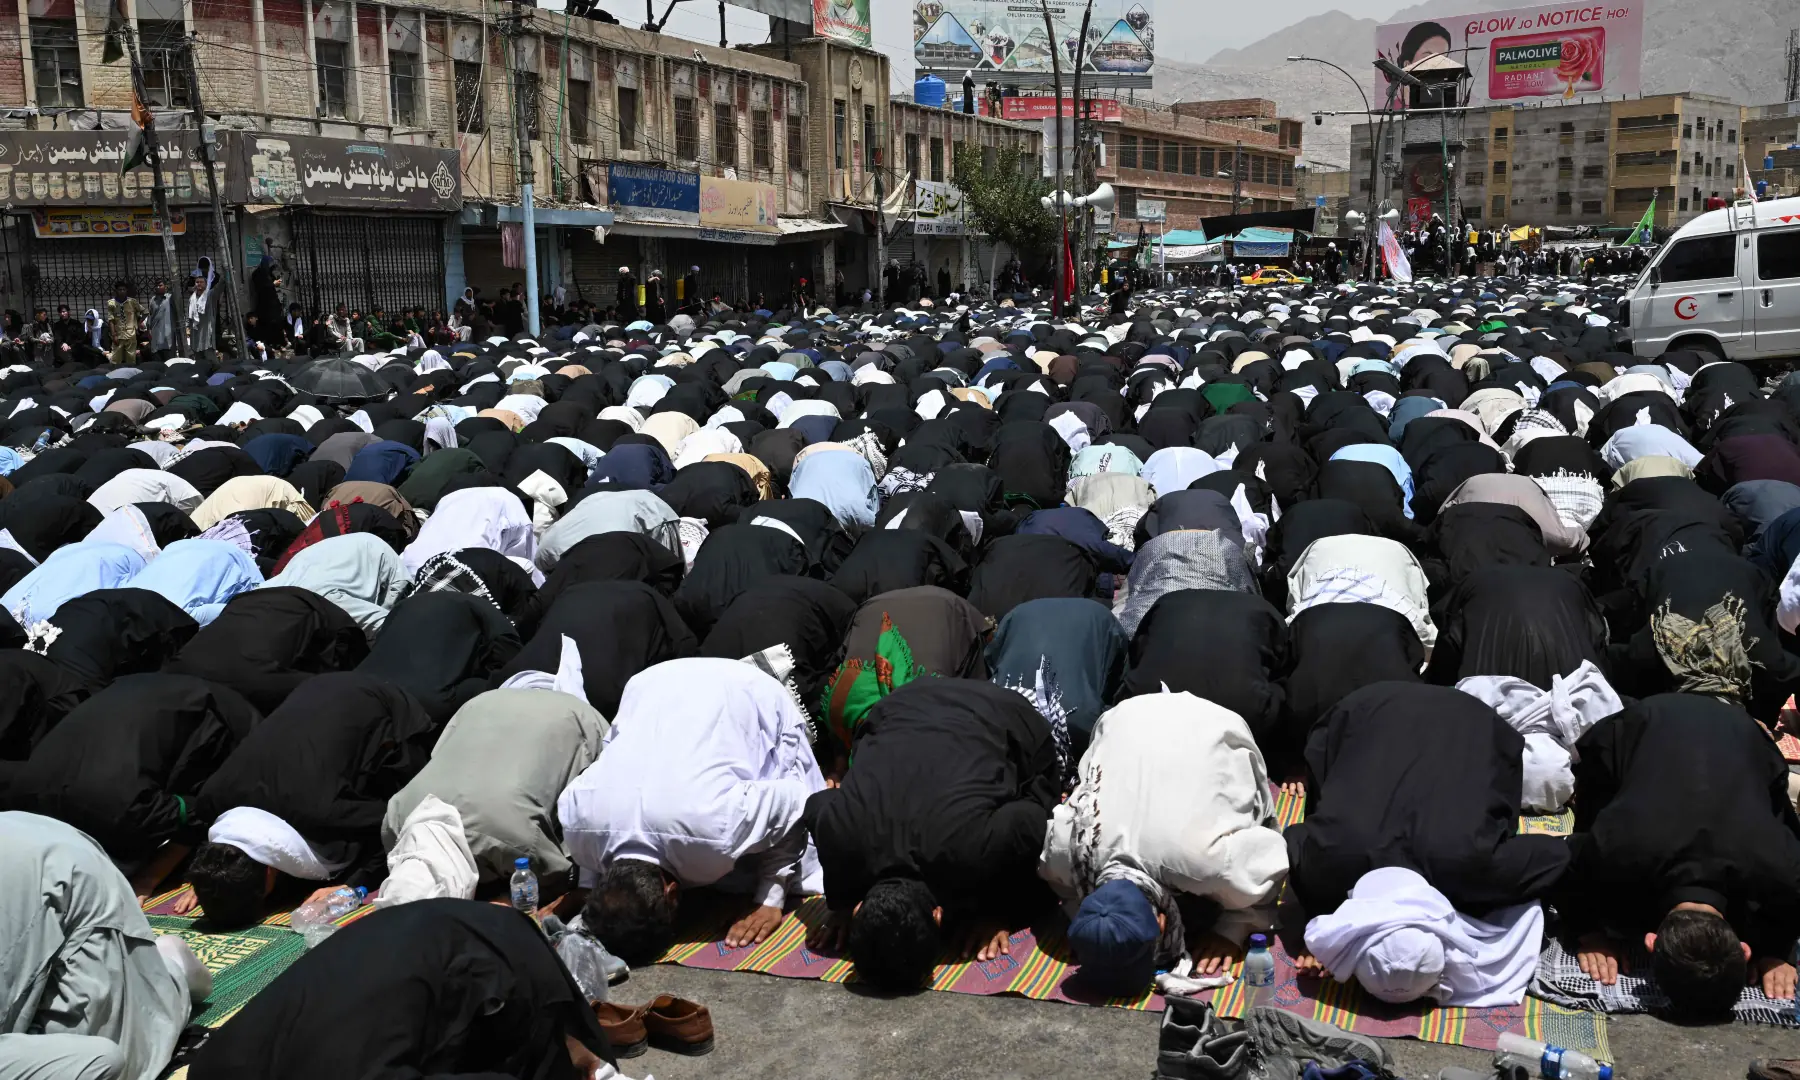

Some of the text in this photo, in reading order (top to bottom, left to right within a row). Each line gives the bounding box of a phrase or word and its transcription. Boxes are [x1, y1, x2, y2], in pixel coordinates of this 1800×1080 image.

[1467, 7, 1629, 34] GLOW JO NOTICE HO!
[1499, 46, 1558, 62] PALMOLIVE
[1504, 71, 1545, 82] RADIANT
[48, 146, 87, 165] میمن
[304, 163, 342, 189] میمن
[396, 165, 429, 193] حاجی
[659, 170, 676, 184] FOOD
[677, 173, 697, 186] STORE
